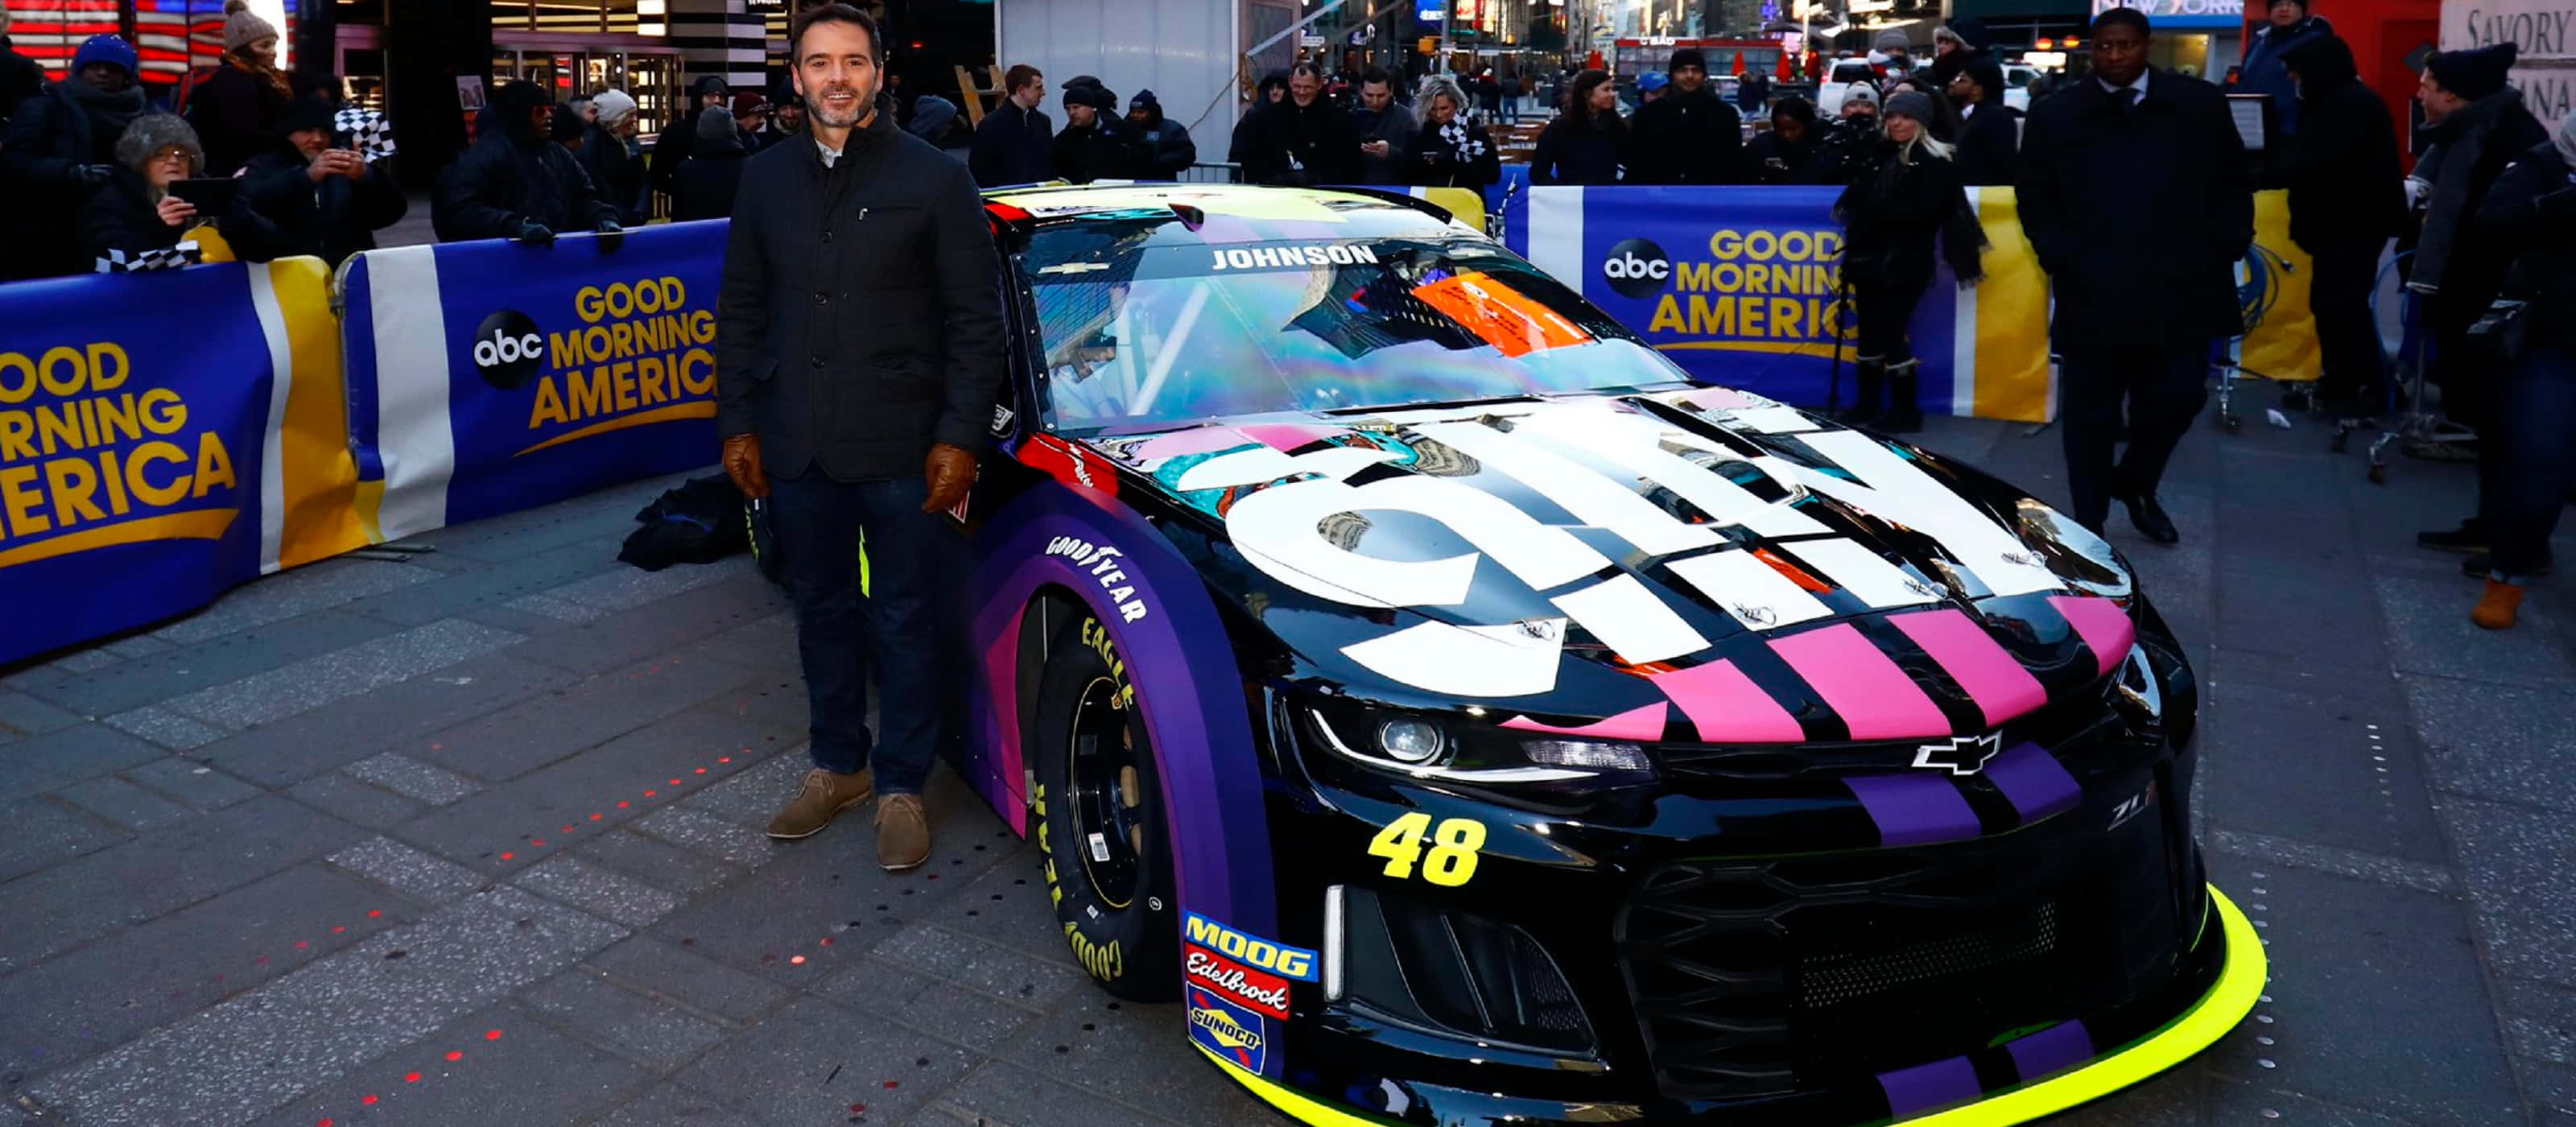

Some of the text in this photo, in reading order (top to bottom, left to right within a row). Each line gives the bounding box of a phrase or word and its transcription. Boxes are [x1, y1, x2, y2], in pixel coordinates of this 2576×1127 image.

[2468, 10, 2573, 55] SAVORY
[1212, 245, 1379, 270] JOHNSON
[1604, 251, 1670, 279] abc
[1710, 229, 1844, 262] GOOD
[575, 276, 685, 323] GOOD
[1676, 262, 1856, 295] MORNIN
[474, 328, 543, 367] abc
[549, 309, 716, 369] MORNING
[529, 348, 718, 429] AMERIC
[0, 431, 235, 541] ERICA
[1046, 536, 1147, 624] GOODYEAR
[1082, 617, 1134, 712] EAGLE
[1367, 811, 1487, 887] 48
[1187, 915, 1311, 977] MOOG
[1187, 952, 1287, 1011] Edelbrock
[1192, 1009, 1258, 1050] SUNOCO
